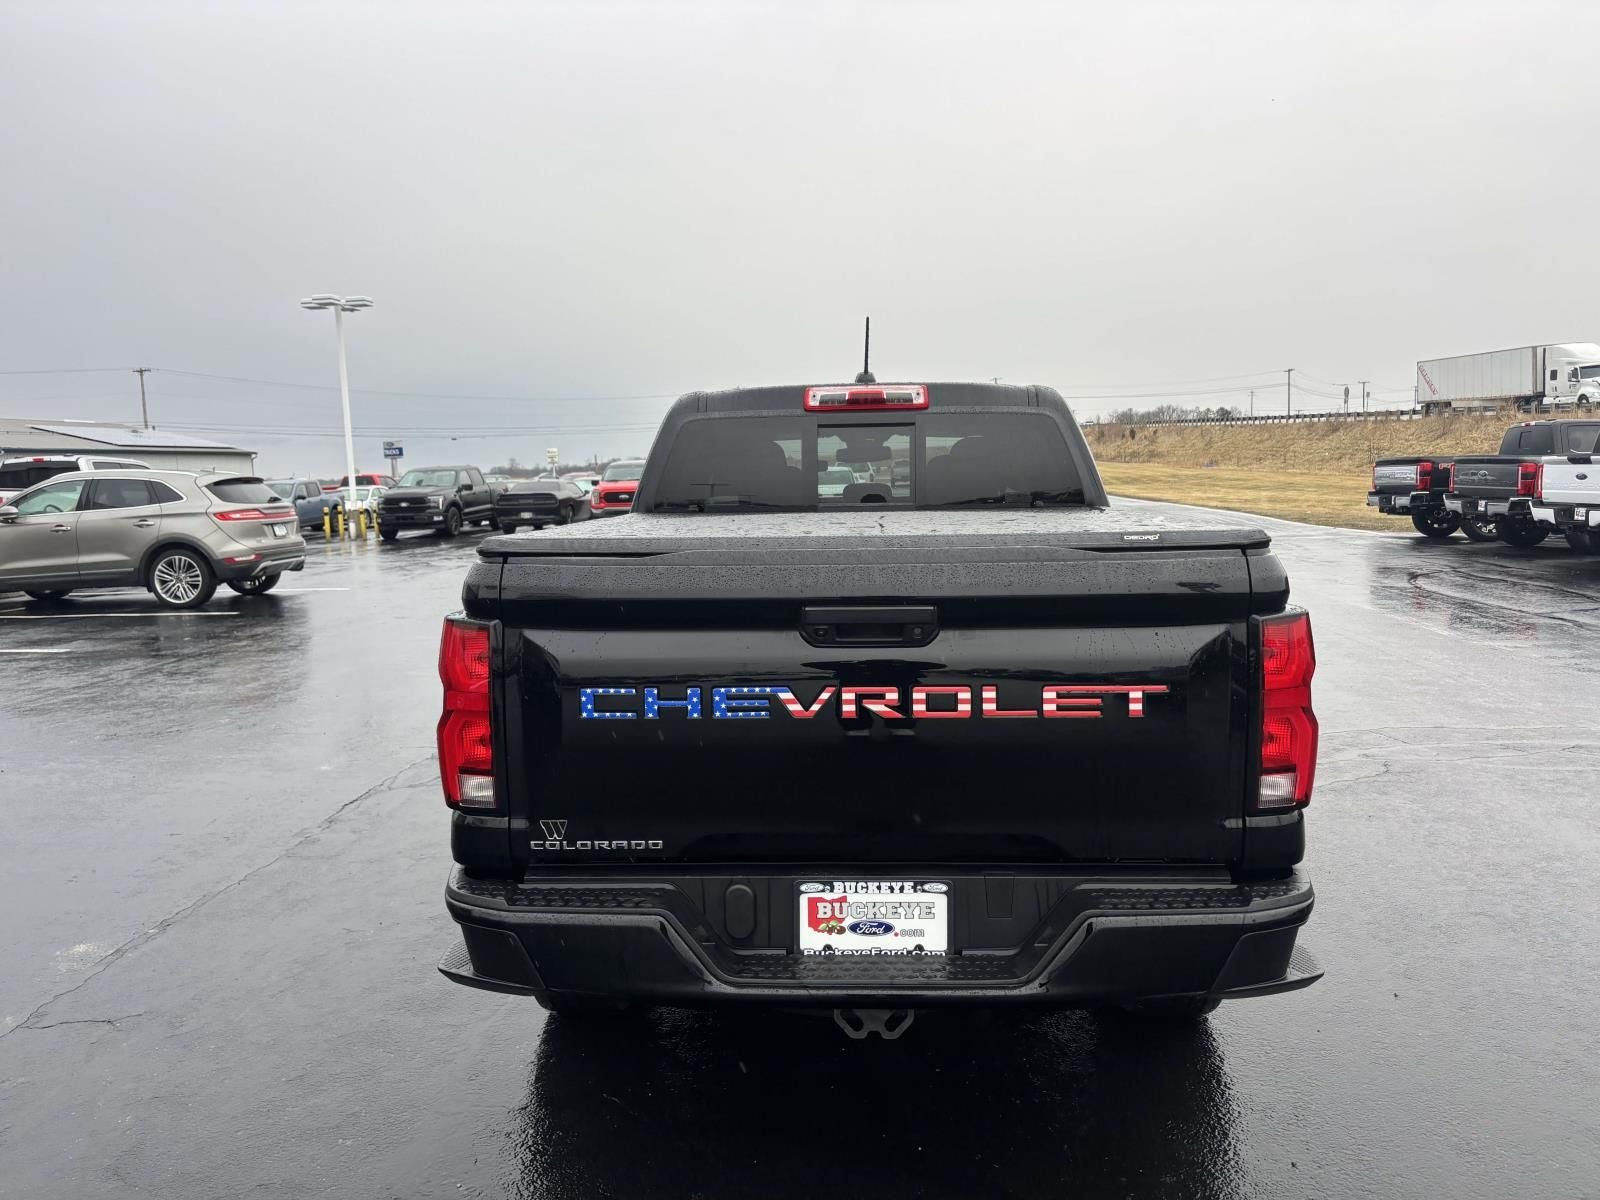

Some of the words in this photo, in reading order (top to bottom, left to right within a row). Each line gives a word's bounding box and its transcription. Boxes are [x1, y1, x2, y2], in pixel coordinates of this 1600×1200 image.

[578, 685, 1169, 719] CHEVROLET
[530, 840, 663, 850] COLORADO
[833, 881, 915, 894] BUCKEYE
[816, 902, 936, 919] BUCKEYE
[856, 922, 886, 934] Ford
